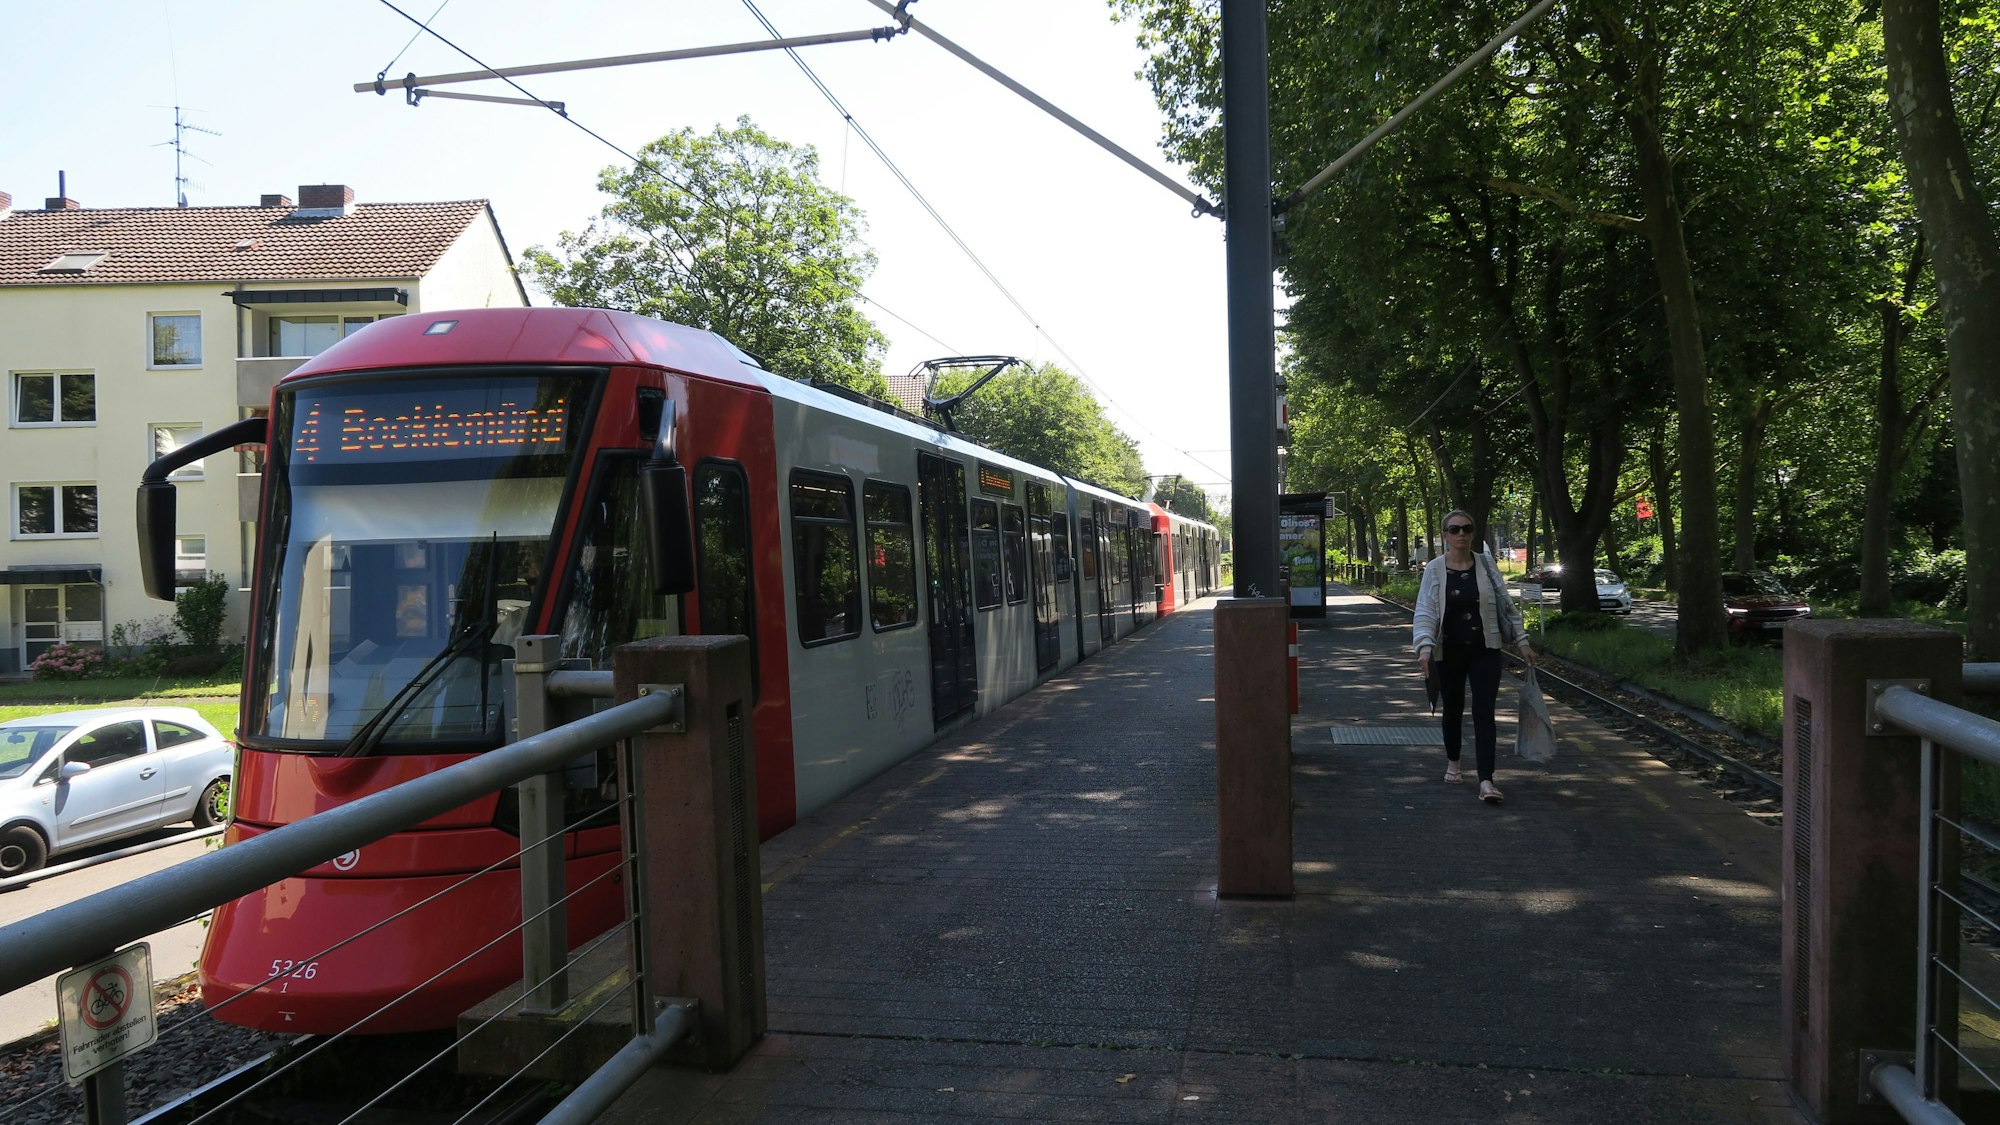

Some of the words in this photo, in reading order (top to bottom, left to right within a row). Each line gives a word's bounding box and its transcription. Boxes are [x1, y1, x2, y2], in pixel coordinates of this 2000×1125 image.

[295, 402, 320, 462] 4
[340, 398, 565, 451] Bocklemünd
[268, 958, 319, 980] 5326
[280, 982, 289, 994] 1
[112, 1015, 147, 1037] abstellen
[92, 1030, 130, 1054] verboten!
